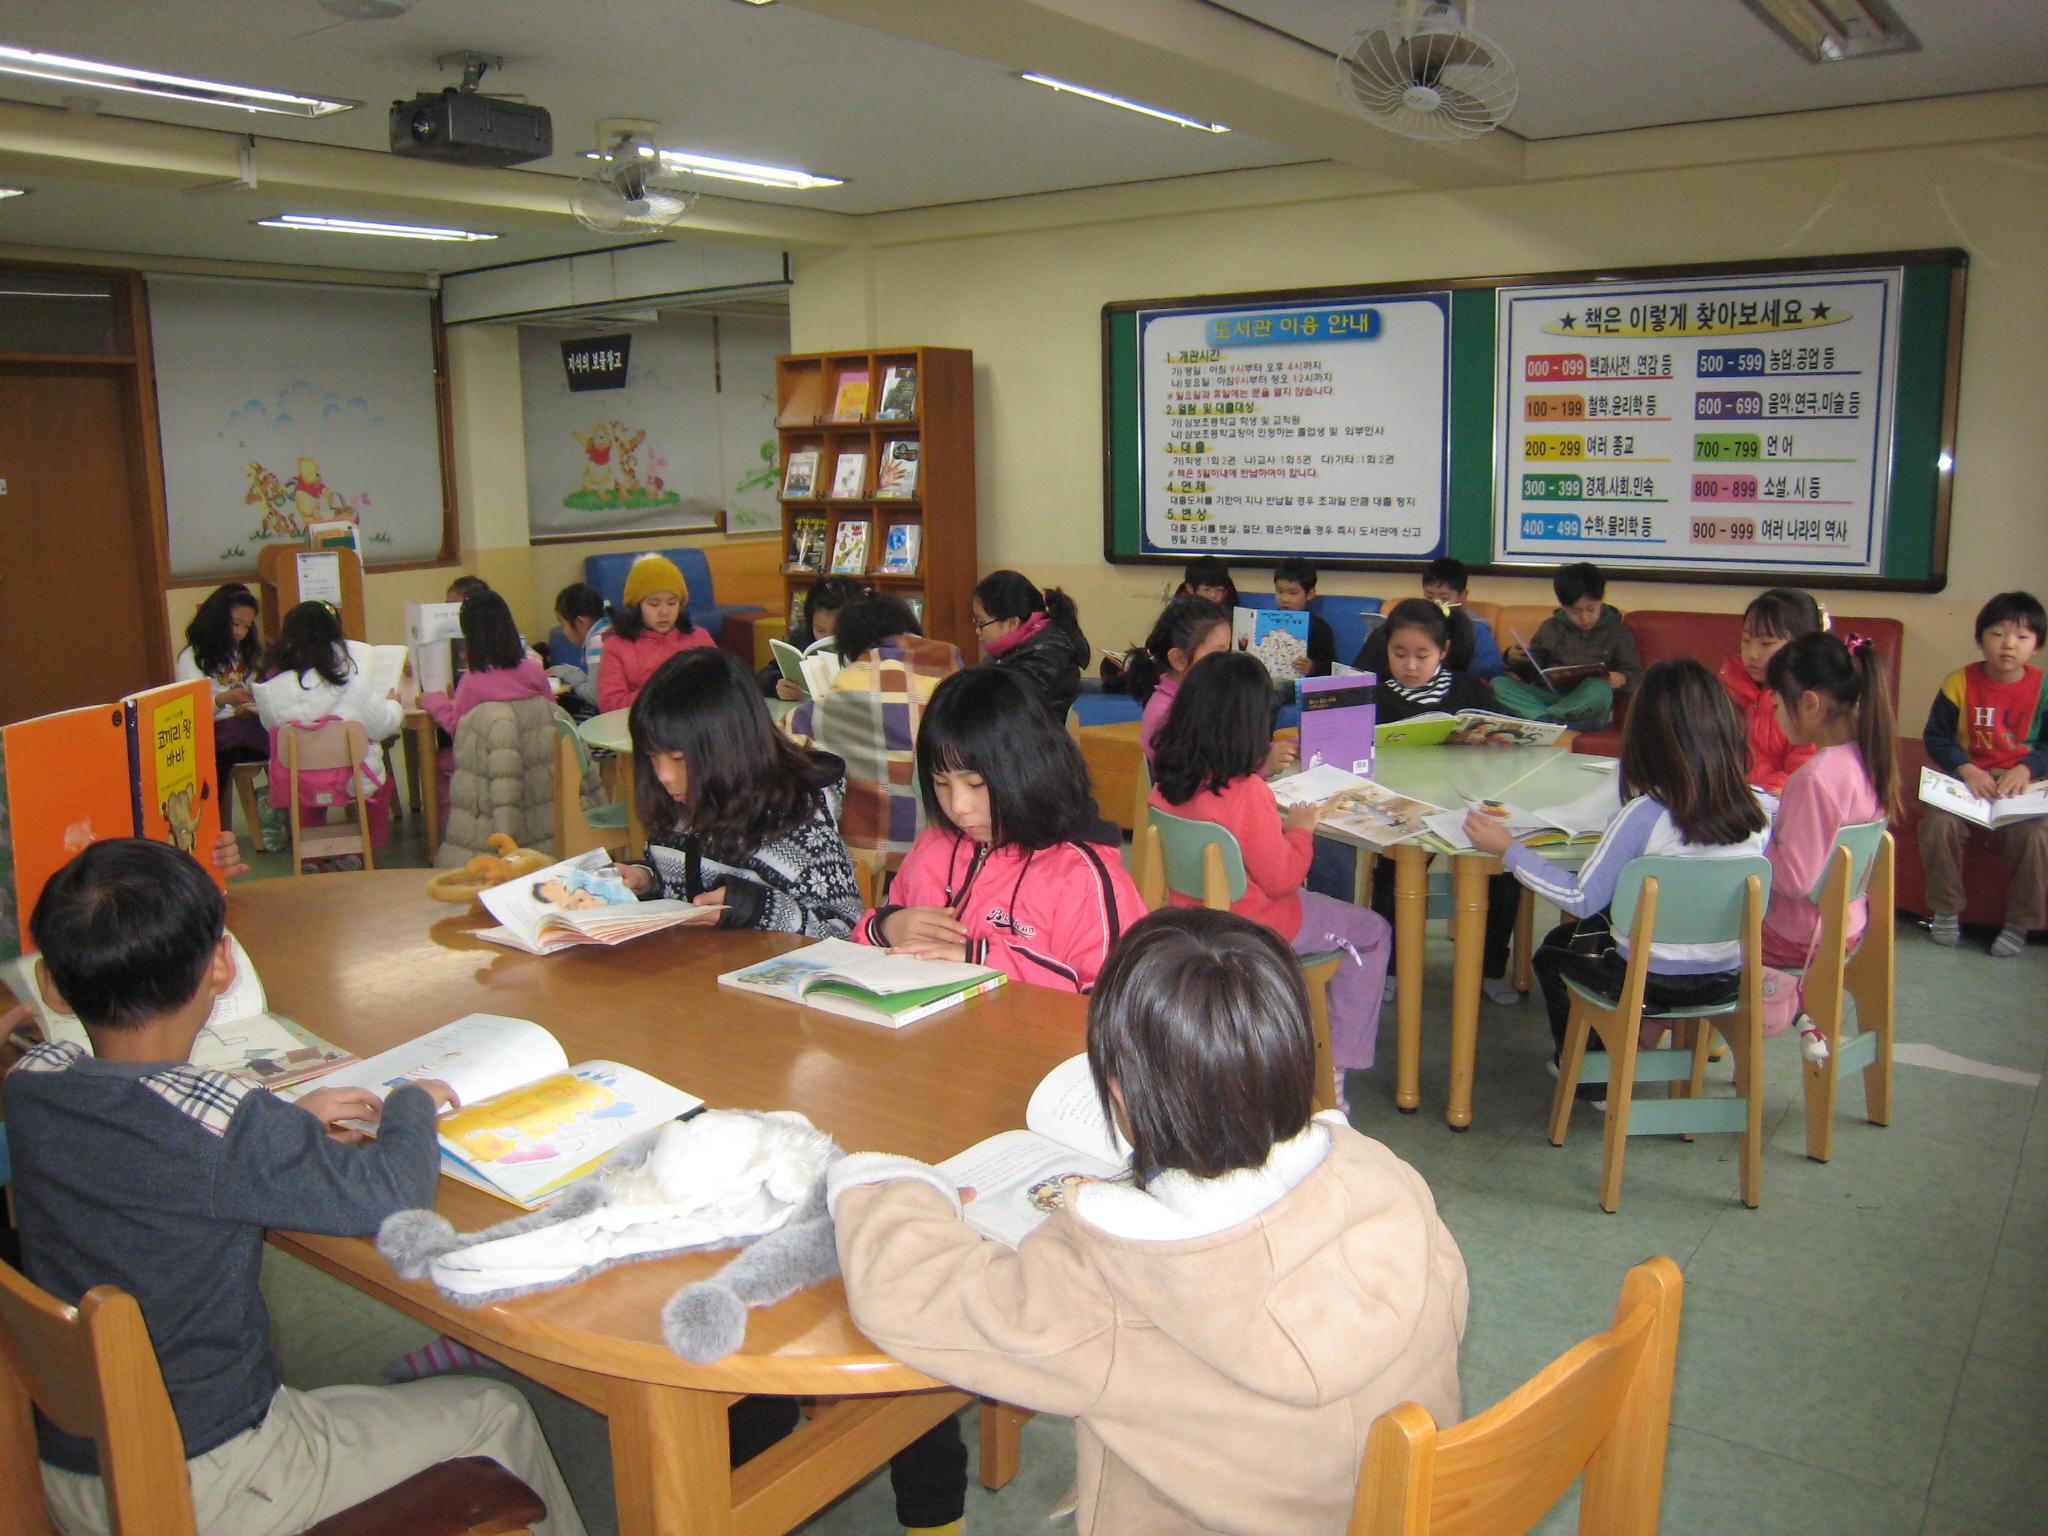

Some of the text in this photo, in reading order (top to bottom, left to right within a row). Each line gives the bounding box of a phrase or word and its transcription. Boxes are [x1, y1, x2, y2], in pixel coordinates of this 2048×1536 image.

[1215, 313, 1370, 339] 도서관 이용 안내
[1584, 299, 1802, 334] 책은 이렇게 찾아보세요
[568, 349, 622, 374] 지식의 보물창고
[1266, 362, 1284, 372] 오후
[1287, 360, 1322, 371] 4시까지
[1527, 360, 1549, 377] 000
[1562, 359, 1584, 375] 099
[1661, 355, 1672, 376] 등
[1700, 355, 1723, 372] 500
[1738, 354, 1763, 371] 599
[1823, 347, 1835, 370] 등
[1527, 401, 1547, 416] 100
[1562, 401, 1583, 416] 199
[1646, 395, 1657, 416] 등
[1698, 398, 1722, 415] 600
[1736, 397, 1760, 415] 699
[1849, 391, 1861, 414] 등
[1297, 427, 1325, 437] 업생
[1525, 440, 1546, 456] 200
[1560, 440, 1581, 456] 299
[1587, 435, 1608, 456] 여러
[1612, 435, 1634, 457] 종교
[1696, 441, 1719, 458] 700
[1734, 441, 1758, 458] 799
[1524, 480, 1545, 496] 300
[1558, 480, 1580, 496] 399
[1695, 481, 1718, 497] 800
[1732, 480, 1756, 497] 899
[1793, 476, 1806, 498] 시
[1809, 476, 1821, 499] 등
[1170, 496, 1213, 505] 대출도서
[1245, 495, 1263, 506] 지나
[1191, 524, 1216, 533] 도서
[1360, 526, 1398, 537] 도서관에
[1402, 527, 1422, 537] 신고
[1523, 519, 1544, 536] 400
[1557, 520, 1578, 536] 499
[1641, 516, 1652, 538] 등
[1693, 522, 1715, 539] 900
[1730, 523, 1754, 540] 999
[1762, 518, 1784, 541] 여러
[1787, 519, 1820, 542] 나라의
[1825, 520, 1847, 542] 역사
[157, 719, 191, 749] 코끼리 왕
[166, 746, 185, 767] 바바
